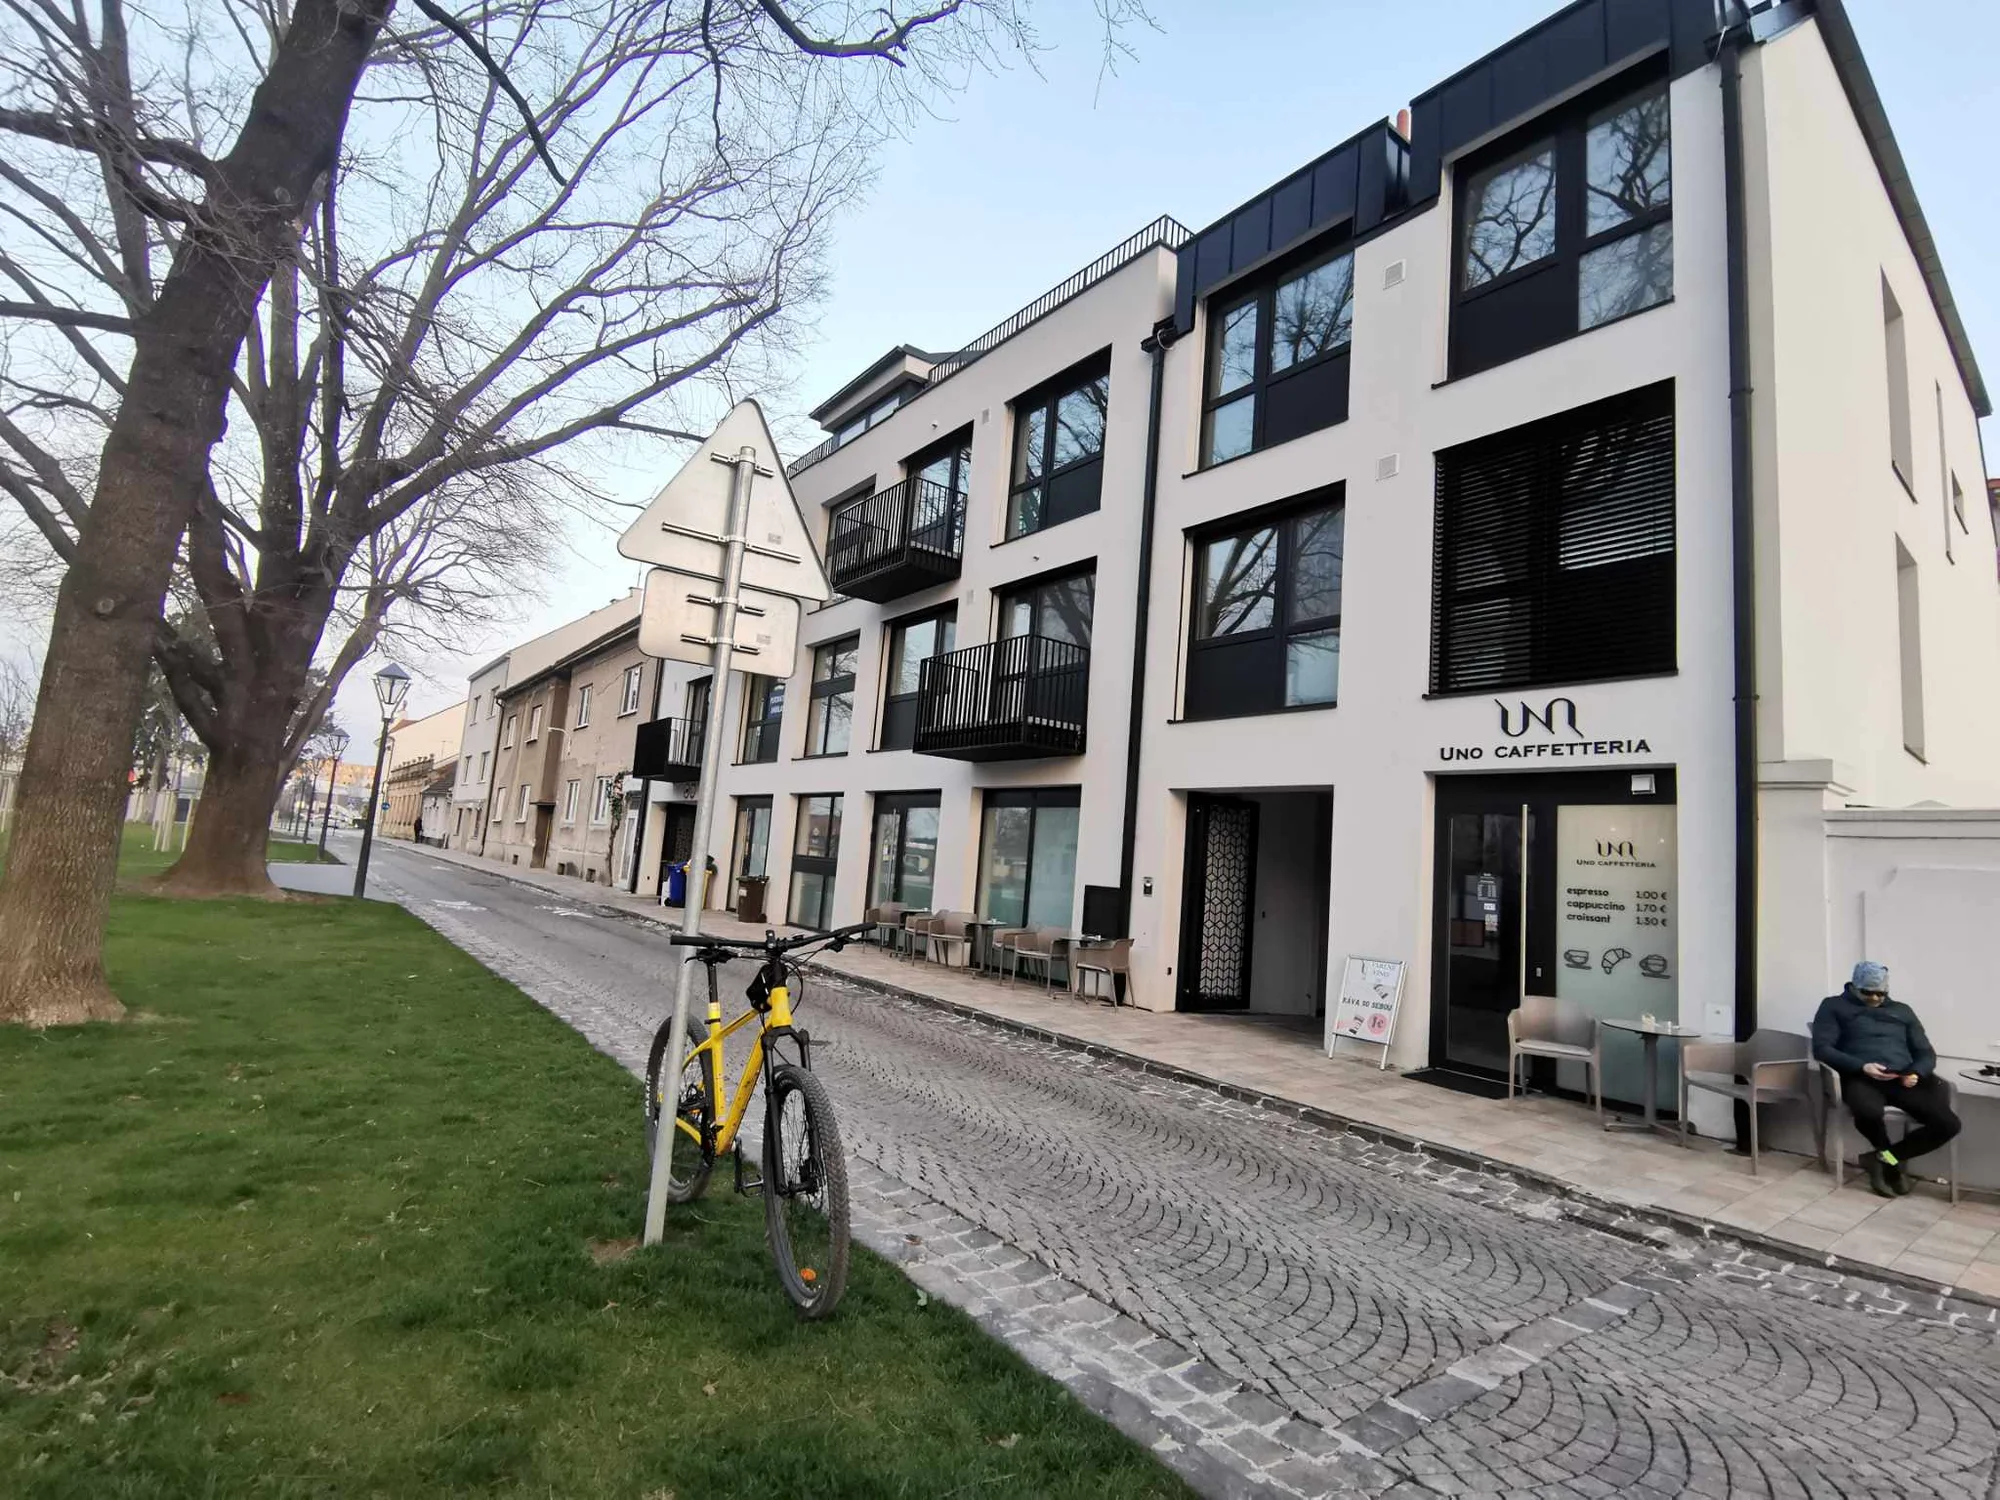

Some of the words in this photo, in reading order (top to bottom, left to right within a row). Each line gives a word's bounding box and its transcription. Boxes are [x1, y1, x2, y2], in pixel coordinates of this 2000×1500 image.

[1494, 739, 1651, 759] CAFFETTERIA
[1566, 887, 1609, 897] espresso
[1566, 900, 1625, 912] cappuccino
[1635, 903, 1657, 913] 1.70
[1566, 913, 1611, 923] croissant
